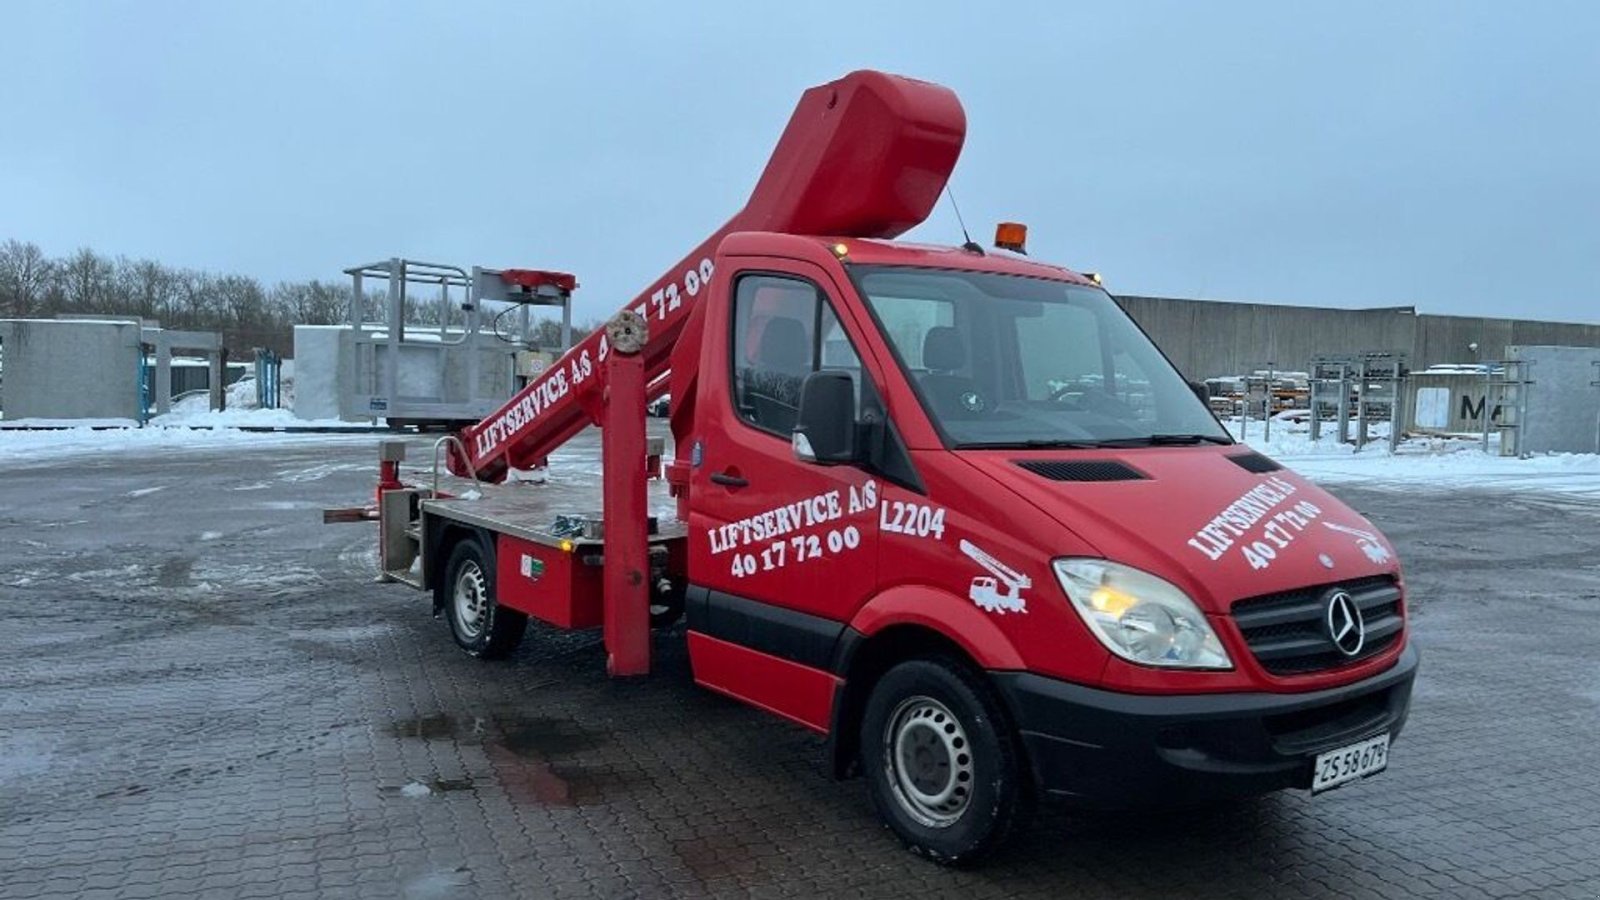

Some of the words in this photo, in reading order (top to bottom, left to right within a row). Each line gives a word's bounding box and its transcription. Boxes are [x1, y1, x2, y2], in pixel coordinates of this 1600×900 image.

[475, 368, 569, 459] LIFTSERVICE
[571, 350, 592, 385] A/S
[651, 283, 681, 320] 72
[684, 258, 714, 296] 00
[708, 489, 842, 555] LIFTSERVICE
[848, 479, 877, 514] A/S
[879, 499, 945, 540] L2204
[1187, 483, 1287, 561] LIFTSERVICE
[1273, 510, 1309, 531] 72
[1294, 500, 1322, 518] 00
[731, 553, 757, 578] 40
[761, 540, 786, 571] 17
[791, 535, 823, 562] 72
[827, 525, 860, 553] 00
[1264, 521, 1294, 549] 17
[1241, 541, 1277, 570] 40
[1320, 756, 1340, 783] ZS
[1342, 749, 1360, 776] 58
